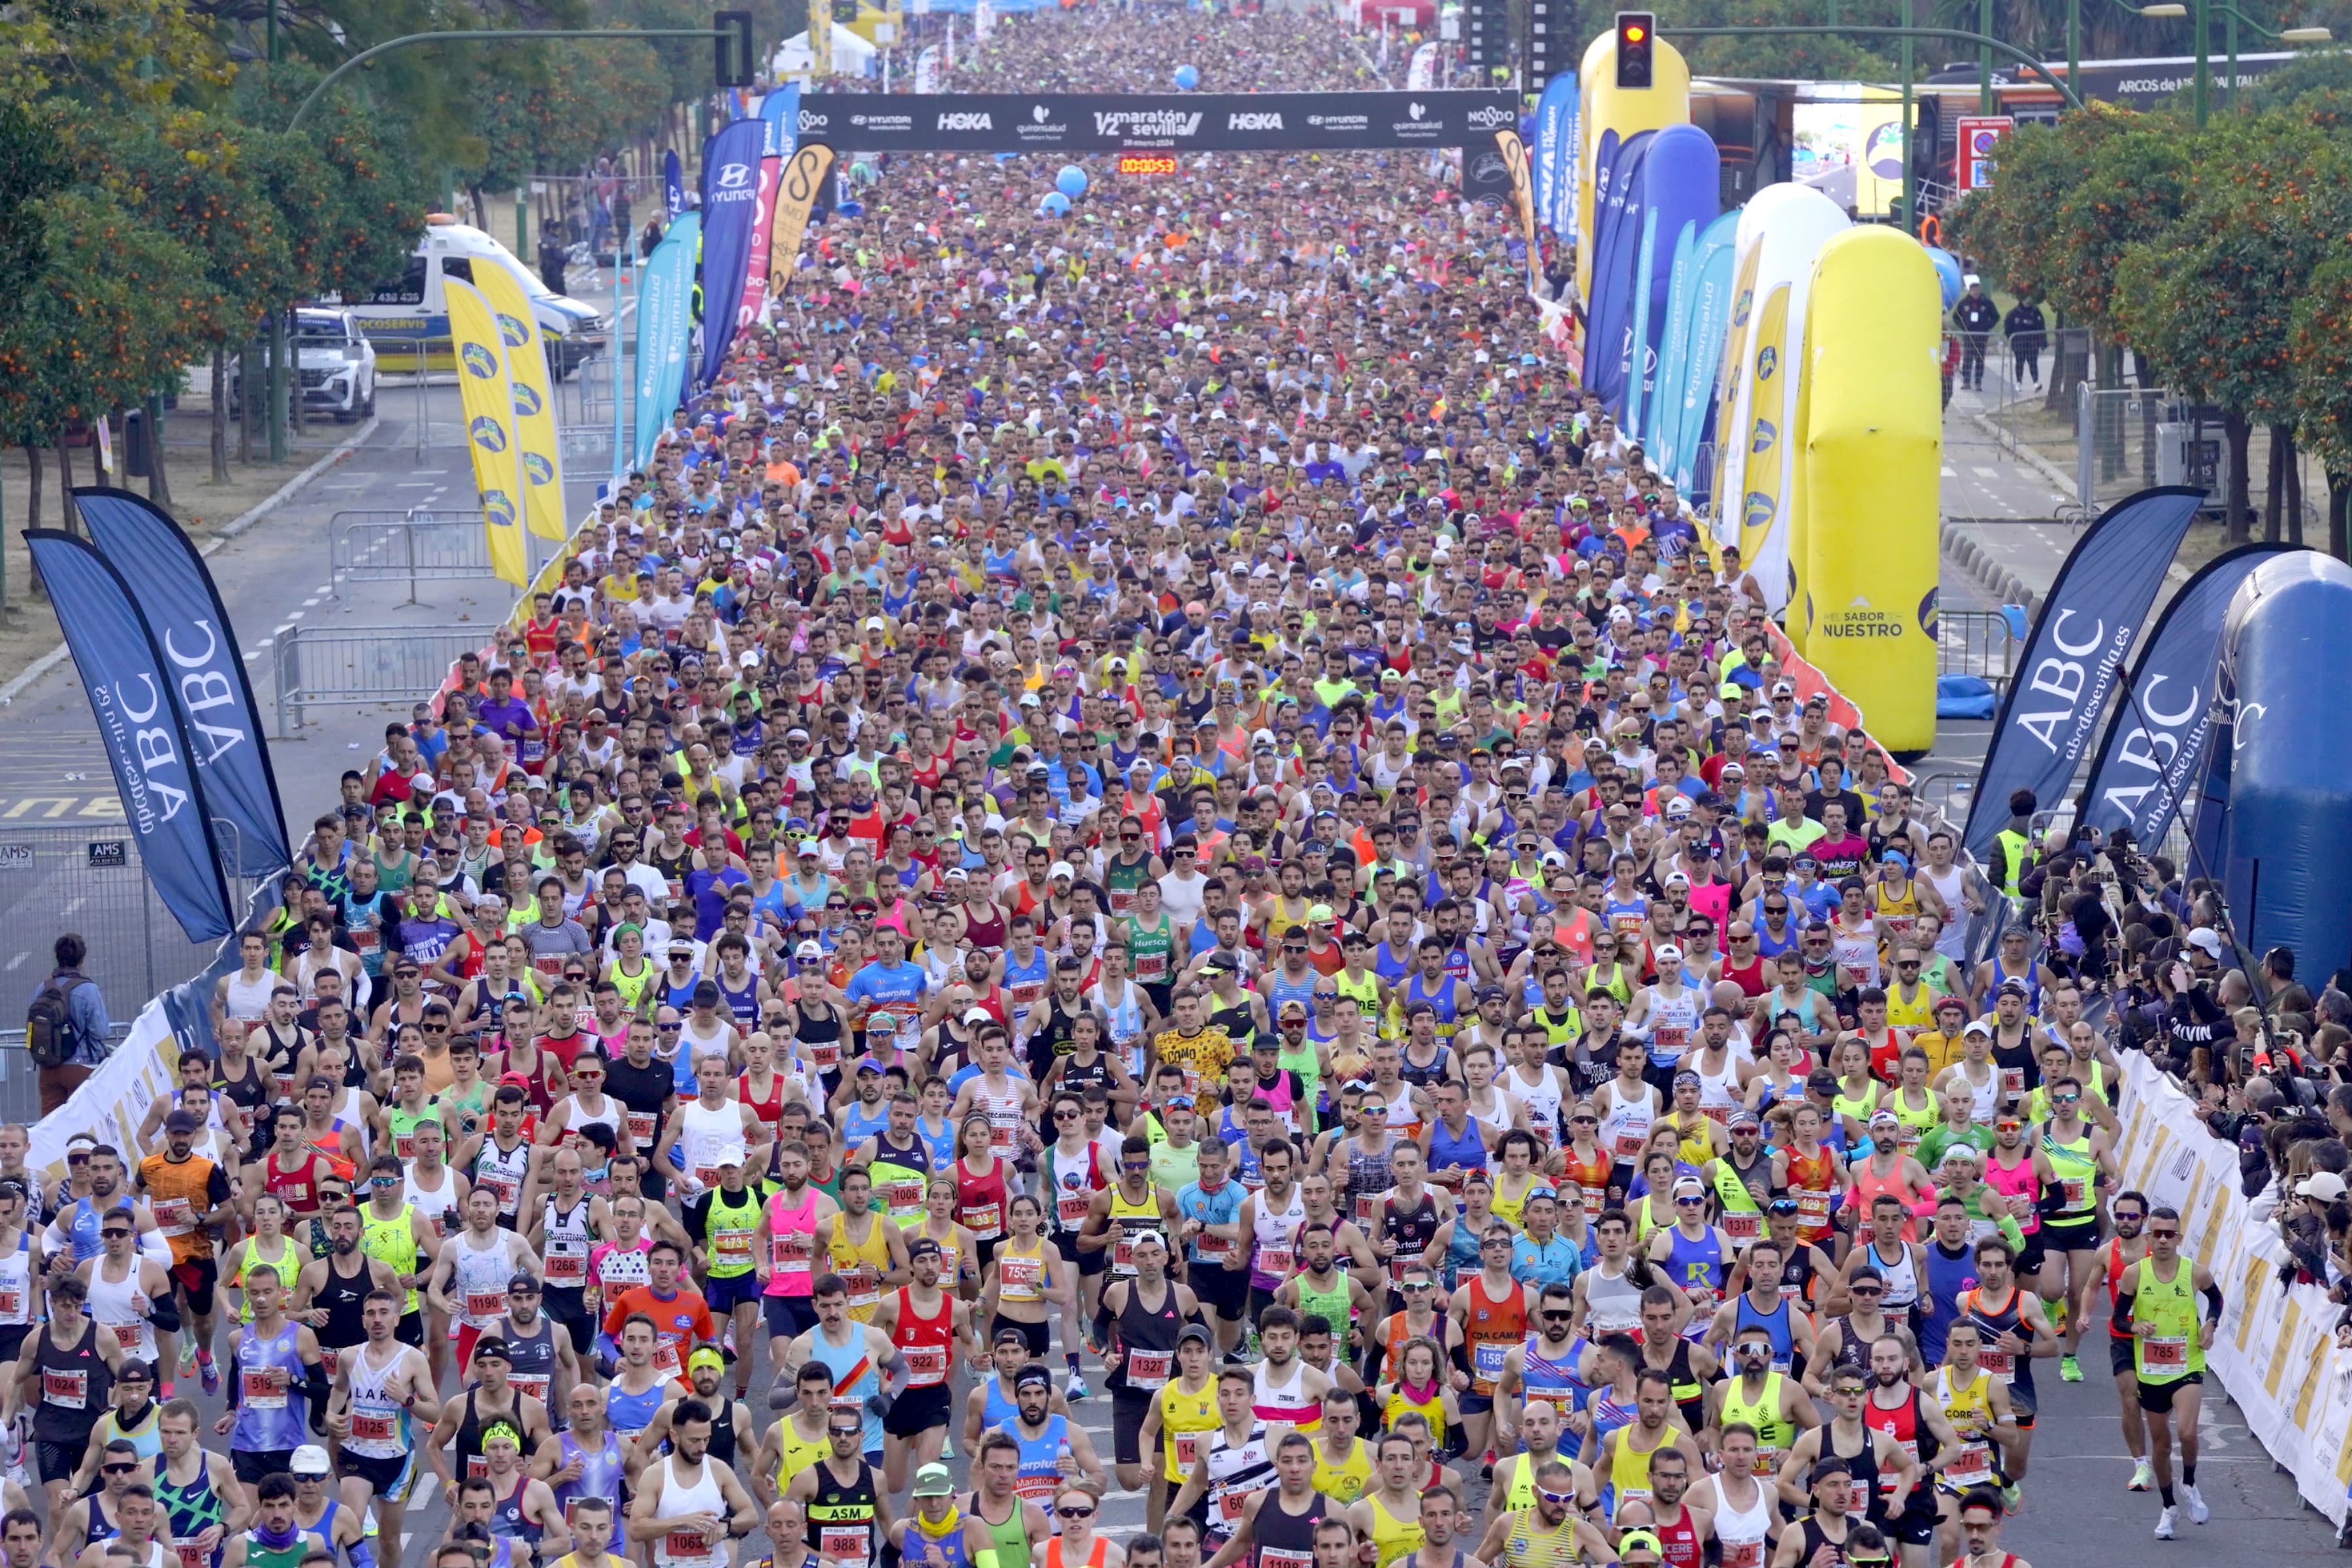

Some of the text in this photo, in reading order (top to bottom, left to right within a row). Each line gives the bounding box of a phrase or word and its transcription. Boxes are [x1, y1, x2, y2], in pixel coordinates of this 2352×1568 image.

[2117, 79, 2159, 93] ARCOS
[2160, 78, 2175, 91] de
[937, 112, 992, 130] HOKA
[1115, 109, 1186, 124] maratón
[1228, 112, 1283, 130] HOKA
[1120, 159, 1175, 172] 00:00:53
[1844, 612, 1884, 621] SABOR
[1823, 623, 1902, 637] NUESTRO
[2016, 608, 2104, 755] ABC
[2065, 625, 2131, 760] abcdesevilla.es
[2104, 674, 2199, 824] ABC
[94, 843, 120, 856] AMS
[1135, 939, 1167, 949] Huesca
[875, 988, 911, 1000] enerplus
[1661, 1030, 1682, 1040] 1364
[815, 1049, 832, 1060] 944
[628, 1120, 645, 1132] 655
[1624, 1140, 1641, 1152] 490
[276, 1183, 307, 1200] ADN
[895, 1188, 917, 1200] 1006
[1064, 1201, 1088, 1213] 1235
[1802, 1198, 1820, 1211] 129
[972, 1215, 988, 1226] 133
[1728, 1220, 1753, 1232] 1317
[552, 1233, 587, 1243] AVEZZANO
[725, 1237, 743, 1249] 173
[551, 1258, 575, 1270] 1266
[1268, 1254, 1290, 1266] 1304
[1688, 1262, 1713, 1288] R
[847, 1277, 864, 1290] 751
[473, 1296, 498, 1308] 1190
[1472, 1331, 1489, 1341] CDA
[652, 1350, 666, 1364] 78
[2153, 1346, 2174, 1358] 785
[912, 1356, 933, 1368] 922
[1137, 1359, 1163, 1372] 1327
[1980, 1355, 2004, 1367] 1159
[51, 1379, 75, 1392] 1024
[252, 1378, 272, 1390] 519
[357, 1419, 384, 1433] 1125
[475, 1466, 487, 1478] 11
[1016, 1477, 1054, 1488] Maratón
[1021, 1488, 1053, 1497] Lucena
[1230, 1495, 1245, 1510] 60
[830, 1508, 860, 1520] ASM
[673, 1535, 702, 1547] 1063
[833, 1538, 856, 1551] 988
[1662, 1543, 1693, 1555] UCERE
[1671, 1554, 1692, 1564] sport
